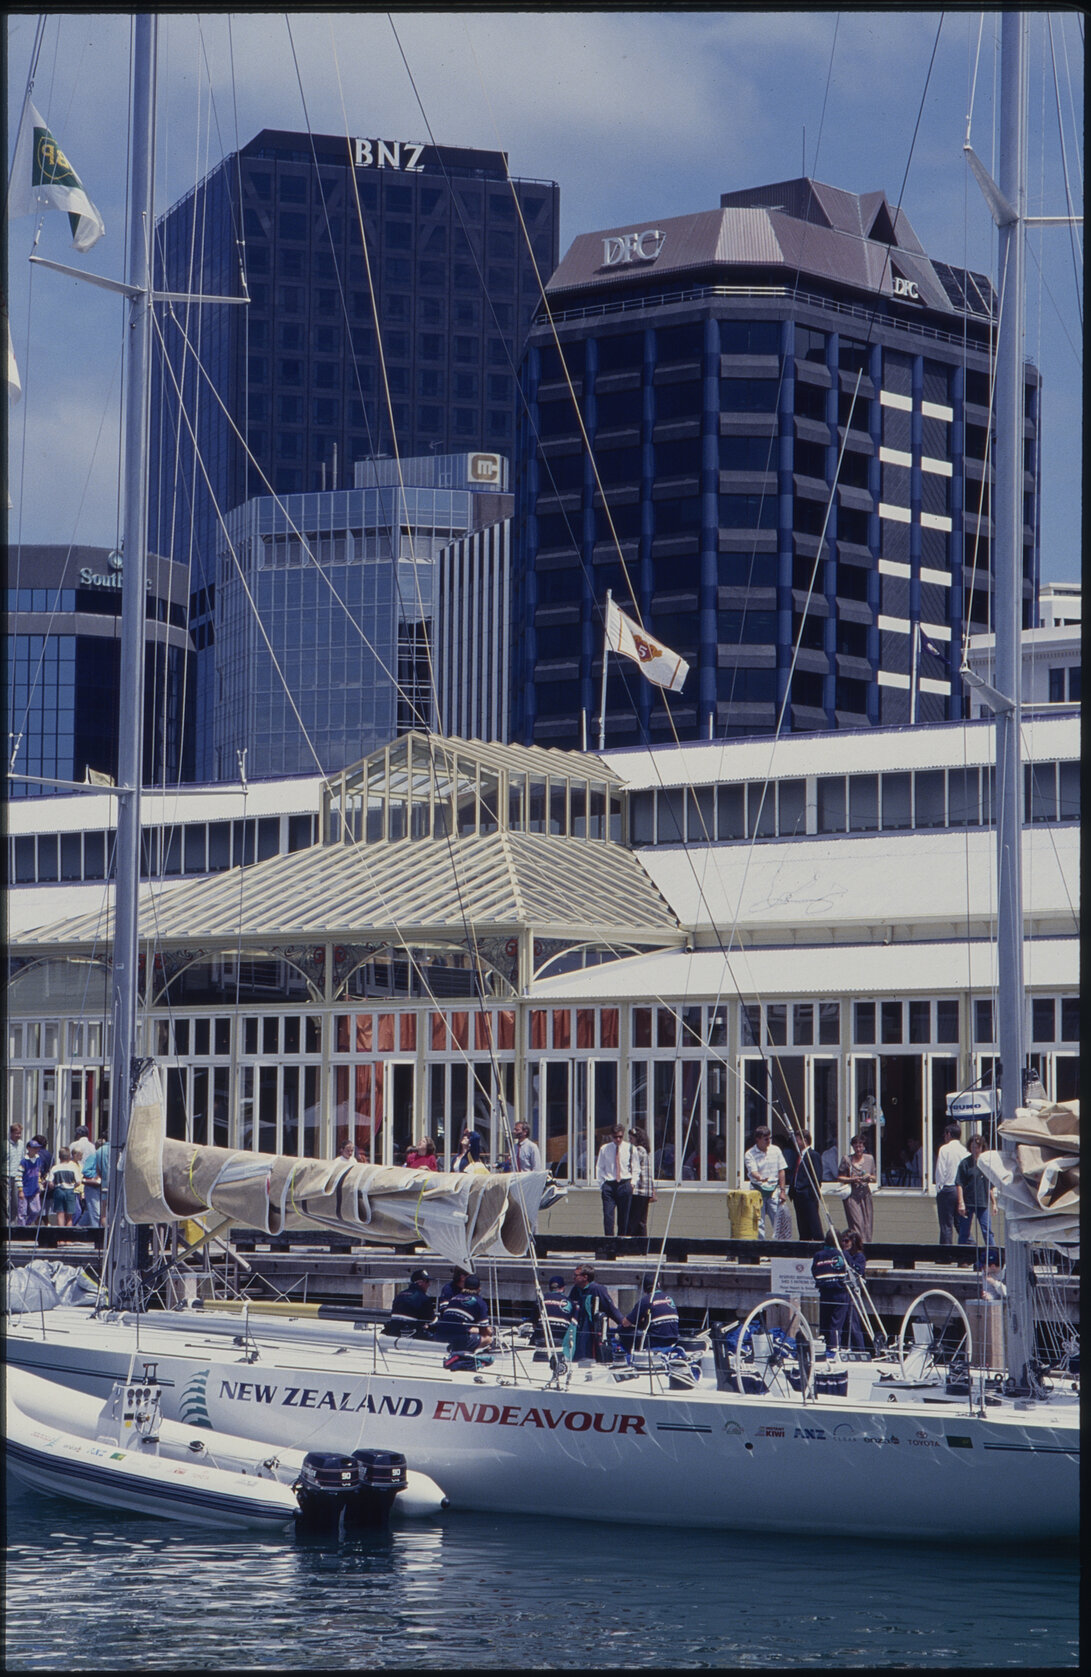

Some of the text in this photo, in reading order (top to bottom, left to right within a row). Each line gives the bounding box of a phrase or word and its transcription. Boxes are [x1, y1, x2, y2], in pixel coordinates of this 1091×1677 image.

[355, 138, 425, 172] BNZ
[601, 230, 664, 266] DFC
[894, 276, 919, 299] DFC
[639, 645, 648, 657] 5
[219, 1380, 648, 1435] NEW ZEALAND ENDEAVOUR
[794, 1428, 827, 1440] ANZ
[907, 1439, 940, 1447] TOYOTA
[341, 1472, 352, 1480] 90
[391, 1468, 401, 1476] 90
